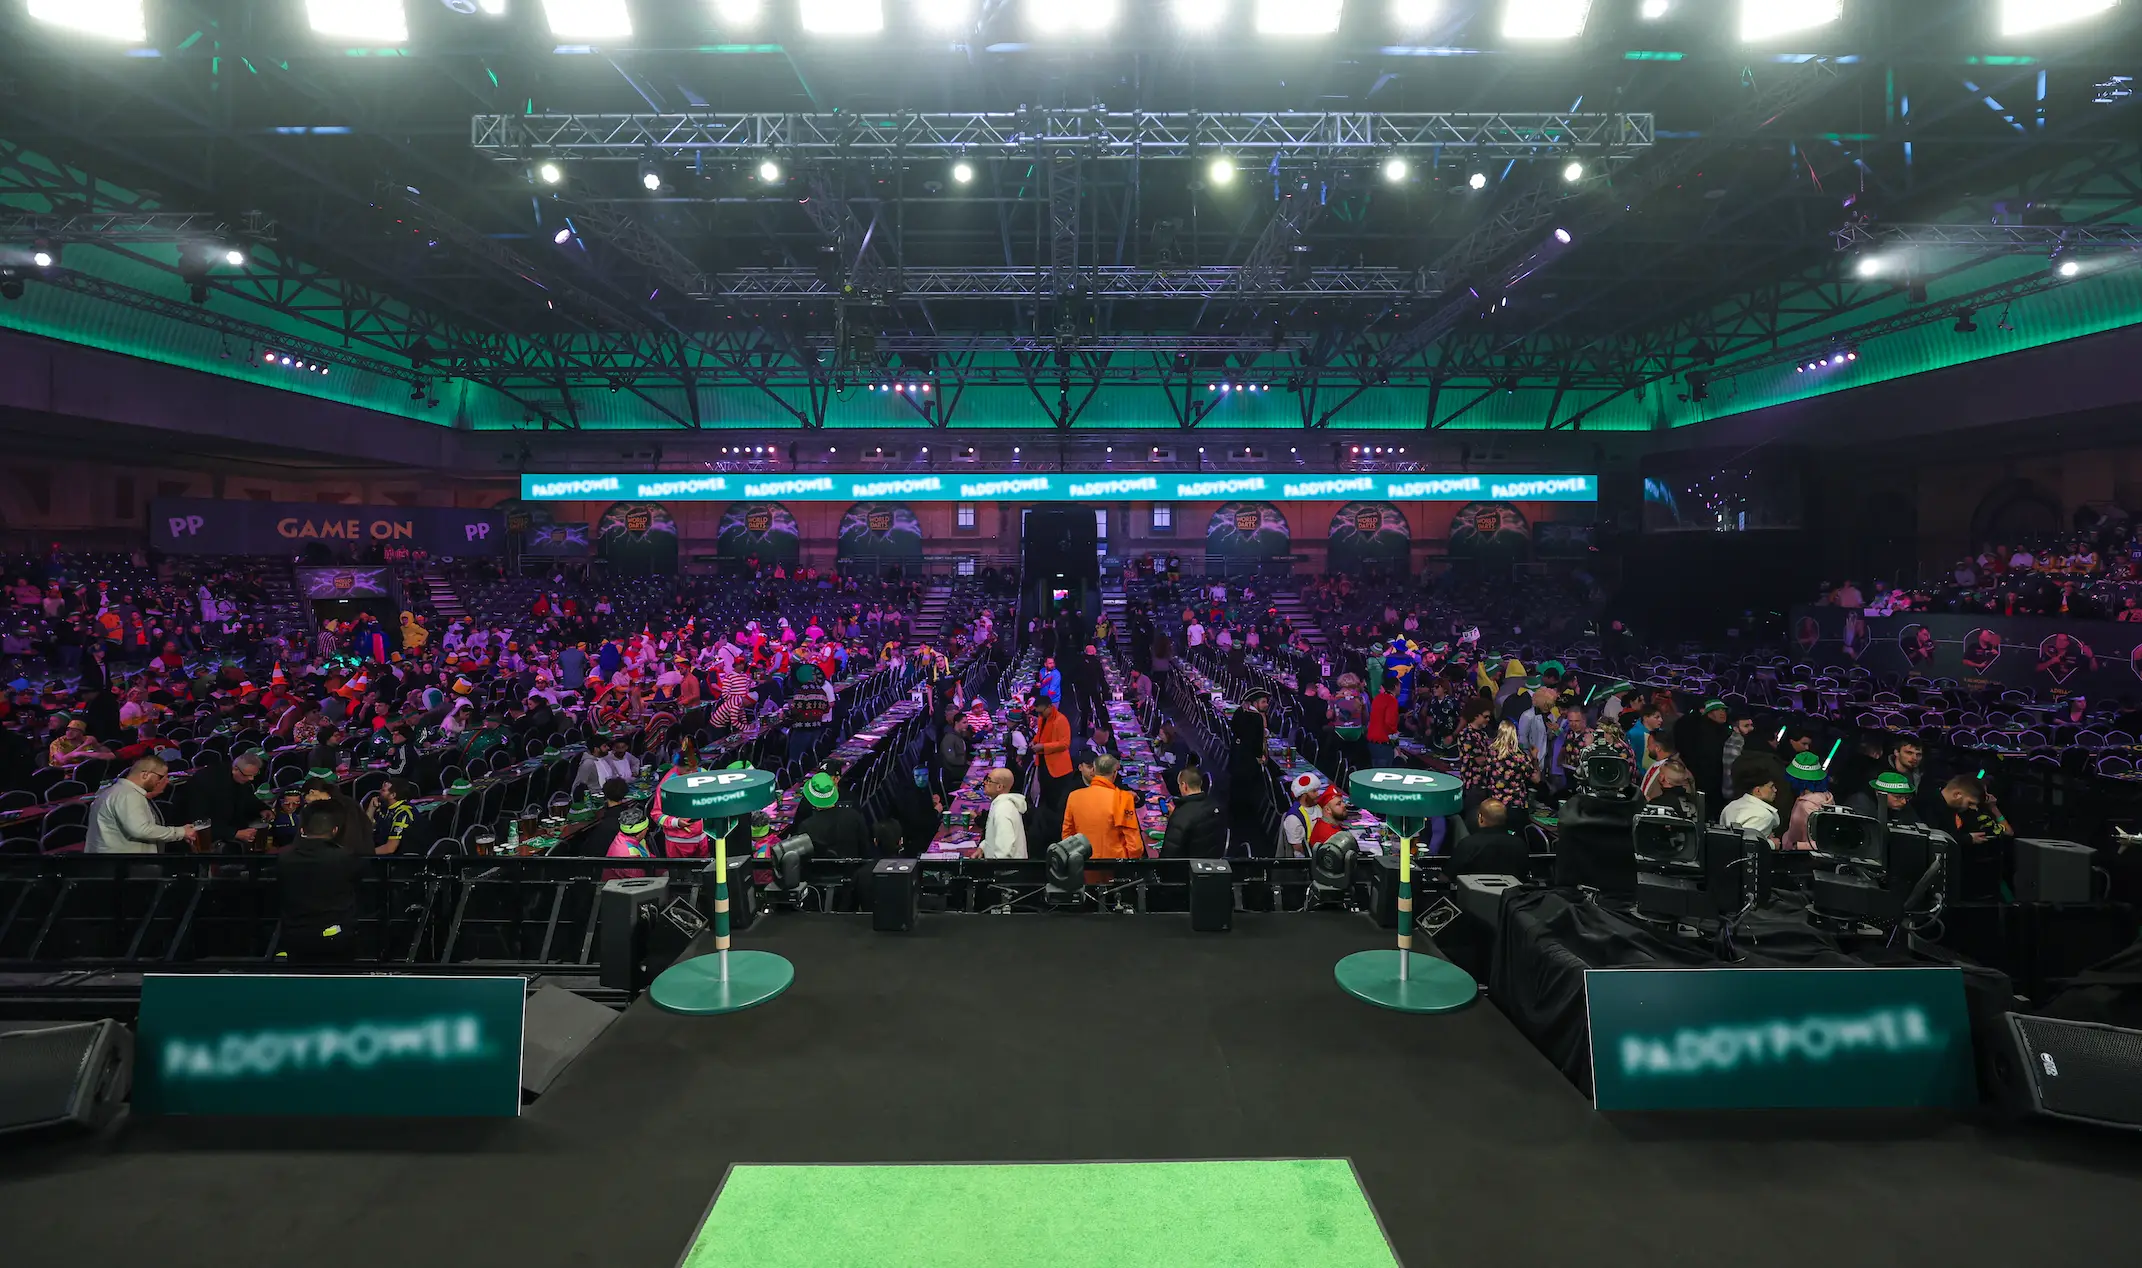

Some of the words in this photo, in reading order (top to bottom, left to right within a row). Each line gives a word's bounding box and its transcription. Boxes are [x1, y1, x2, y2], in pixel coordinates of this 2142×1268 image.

[169, 515, 204, 538] PP
[277, 518, 360, 539] GAME
[369, 520, 413, 540] ON
[464, 522, 491, 542] PP
